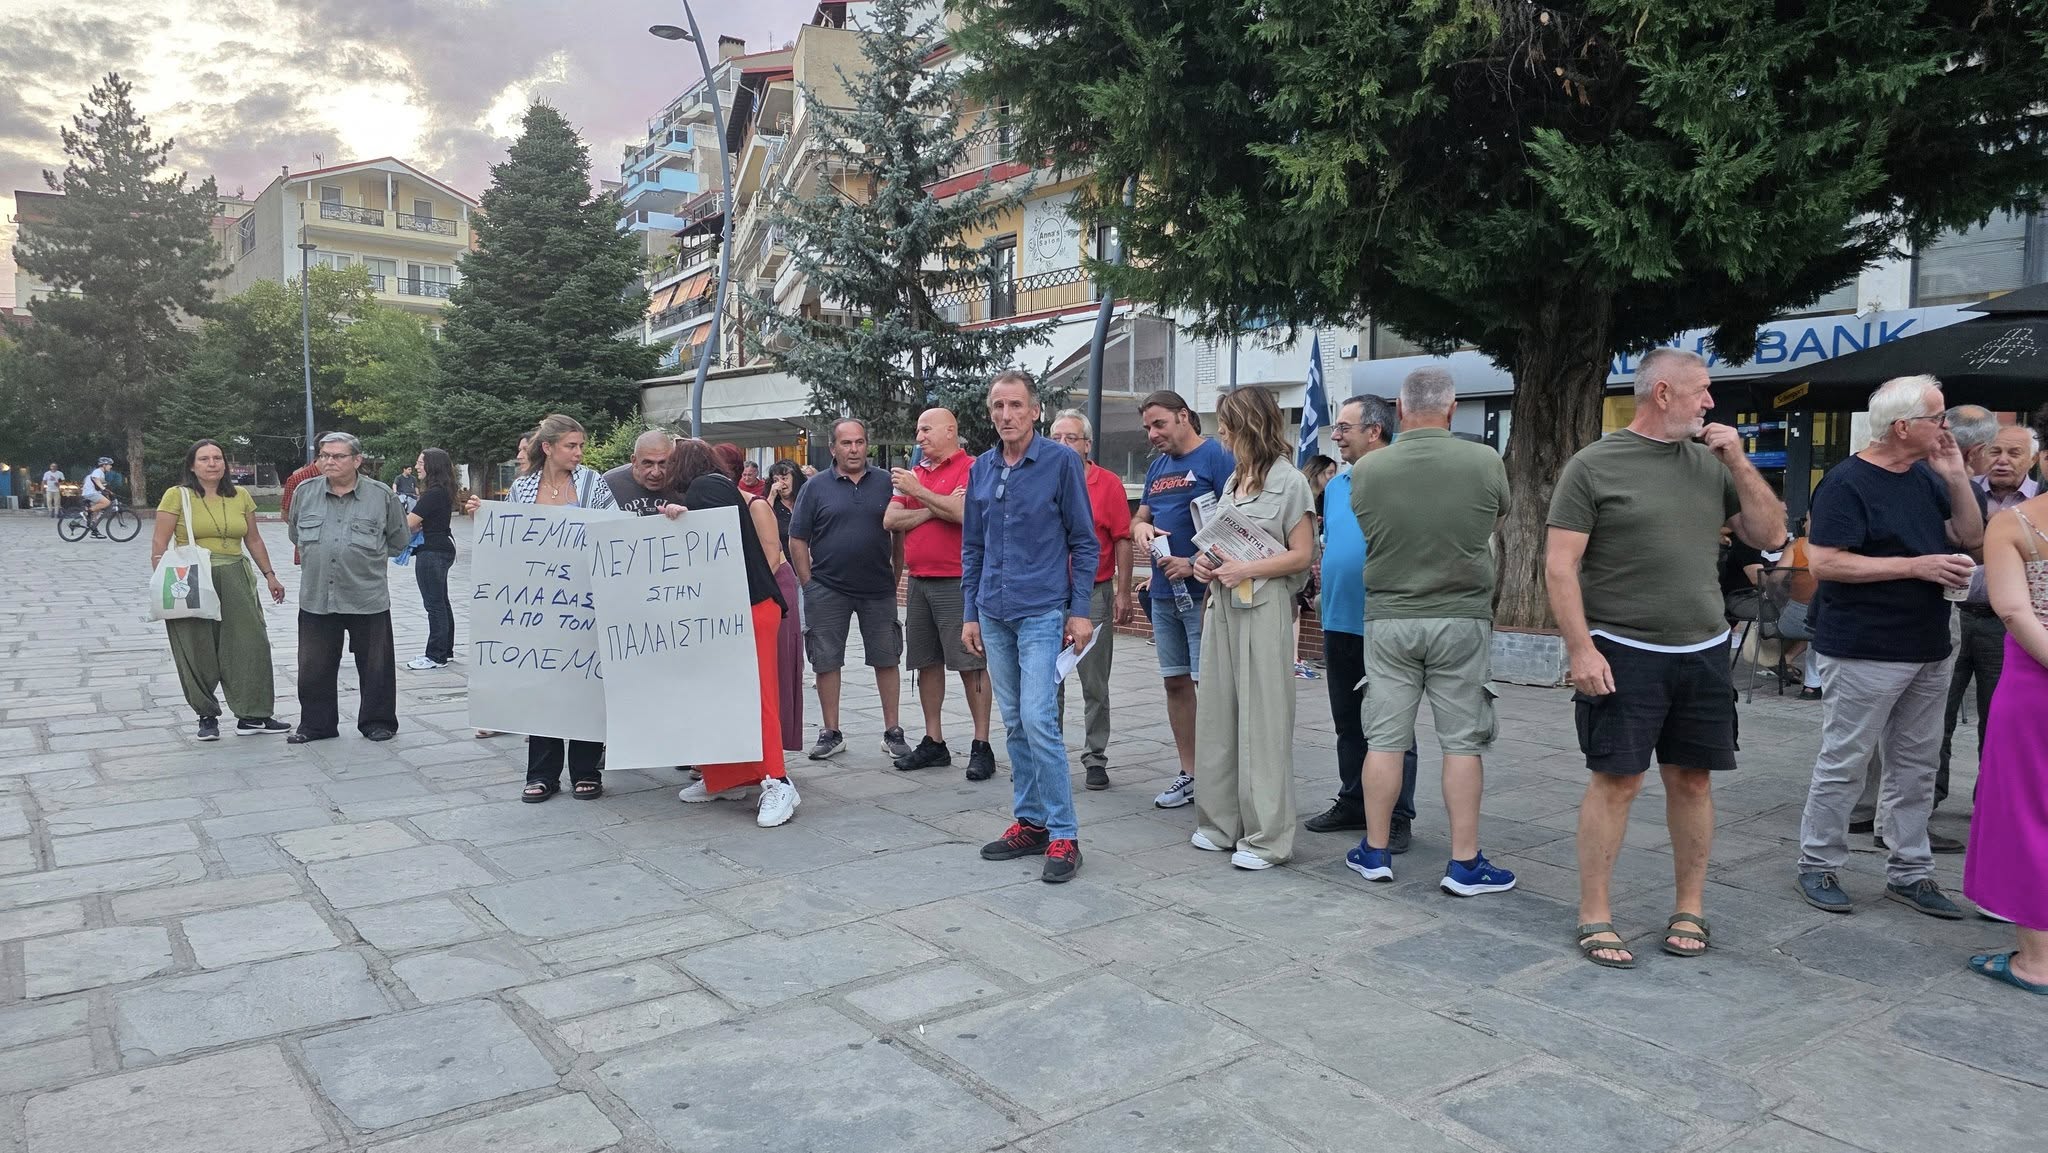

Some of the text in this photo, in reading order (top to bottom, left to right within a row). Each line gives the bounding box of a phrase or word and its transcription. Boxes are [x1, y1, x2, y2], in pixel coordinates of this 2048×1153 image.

[1755, 318, 1918, 364] BANK
[620, 497, 649, 512] OPY
[591, 530, 730, 578] ΛΕΥΤΕΡΙΑ
[525, 560, 572, 581] ΤΗΣ
[473, 583, 595, 610] ΕΛΛΑΔΑΣ
[646, 582, 702, 603] ΣΤΗΝ
[500, 608, 596, 631] ΑΠΟ ΤΟΝ
[607, 613, 744, 661] ΠΑΛΑΙΣΤΙΝΗ
